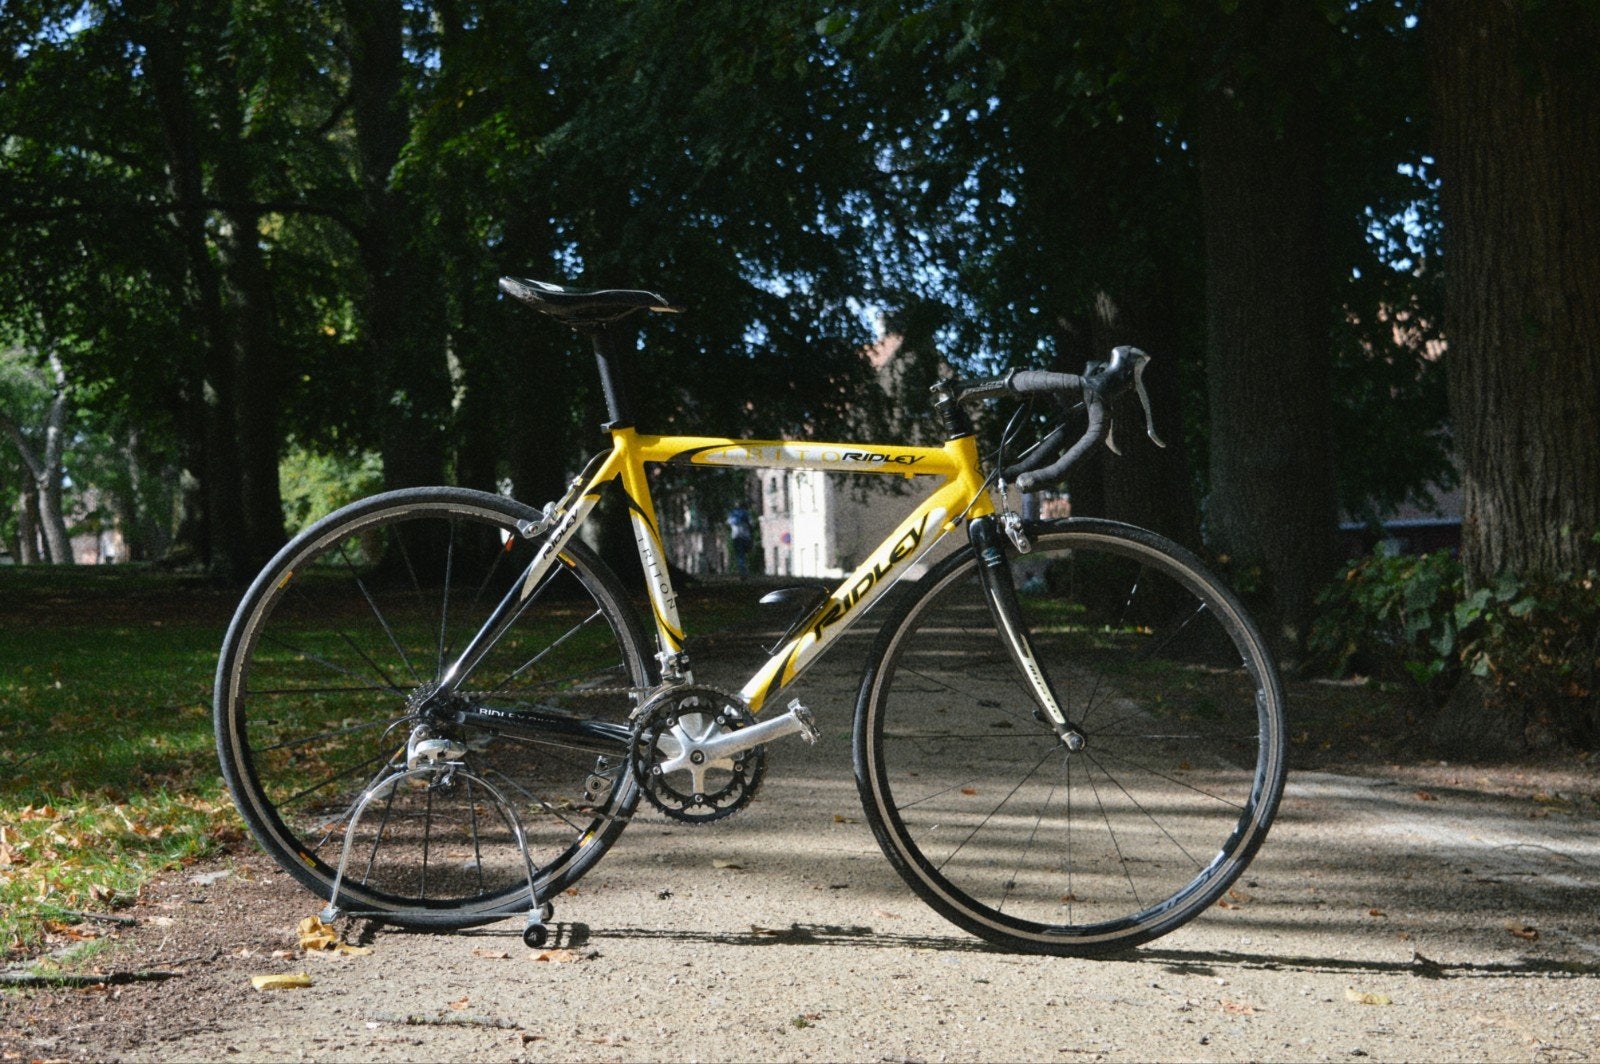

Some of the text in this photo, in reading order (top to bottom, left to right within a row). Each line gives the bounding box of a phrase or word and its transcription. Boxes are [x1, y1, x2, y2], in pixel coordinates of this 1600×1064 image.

[842, 452, 927, 466] RIDLEY
[543, 509, 578, 560] RIDLEY
[637, 537, 677, 610] TRITON
[814, 511, 931, 643] RIDLEY
